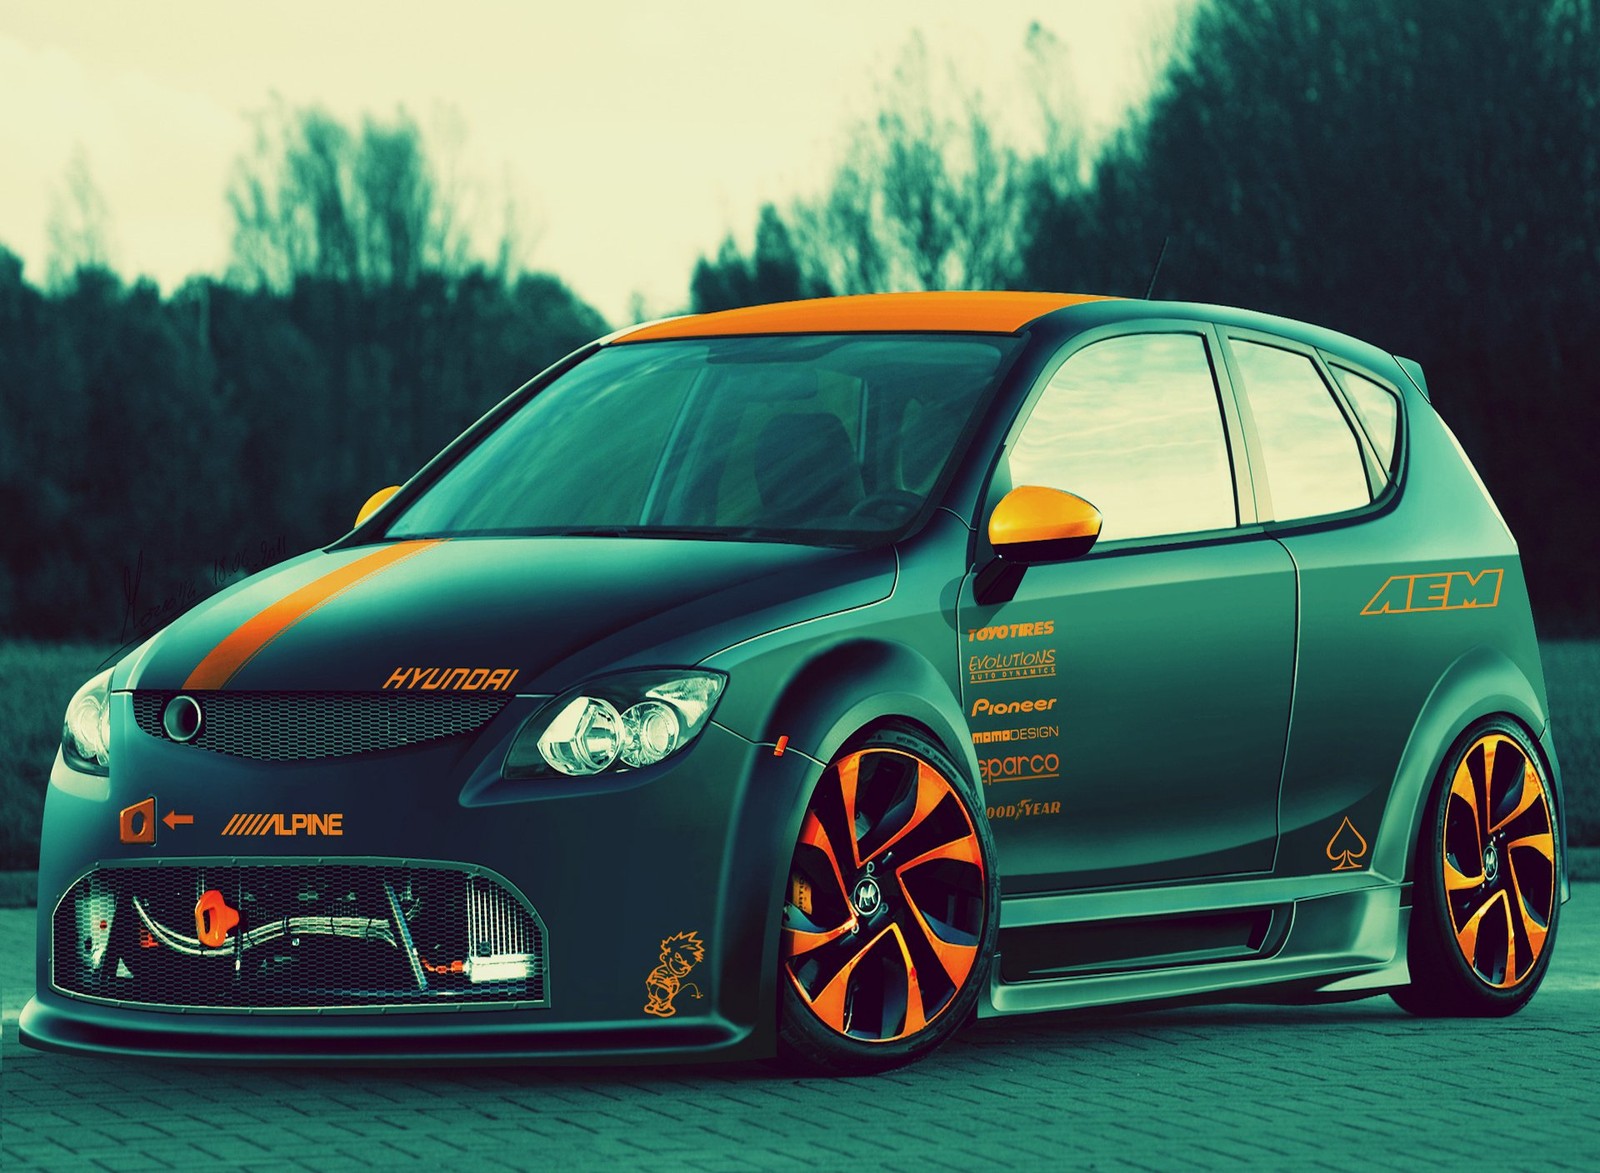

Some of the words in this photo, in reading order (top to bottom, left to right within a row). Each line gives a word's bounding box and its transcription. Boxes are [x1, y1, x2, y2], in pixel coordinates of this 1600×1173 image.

[1360, 569, 1504, 615] AEM
[969, 649, 1056, 672] EVOLUTIONS
[382, 667, 519, 691] HYUNDAI
[970, 671, 996, 681] AUTO
[1002, 666, 1056, 678] DYNAMICS
[972, 699, 1057, 717] Pioneer
[985, 799, 1061, 820] OODYEAR
